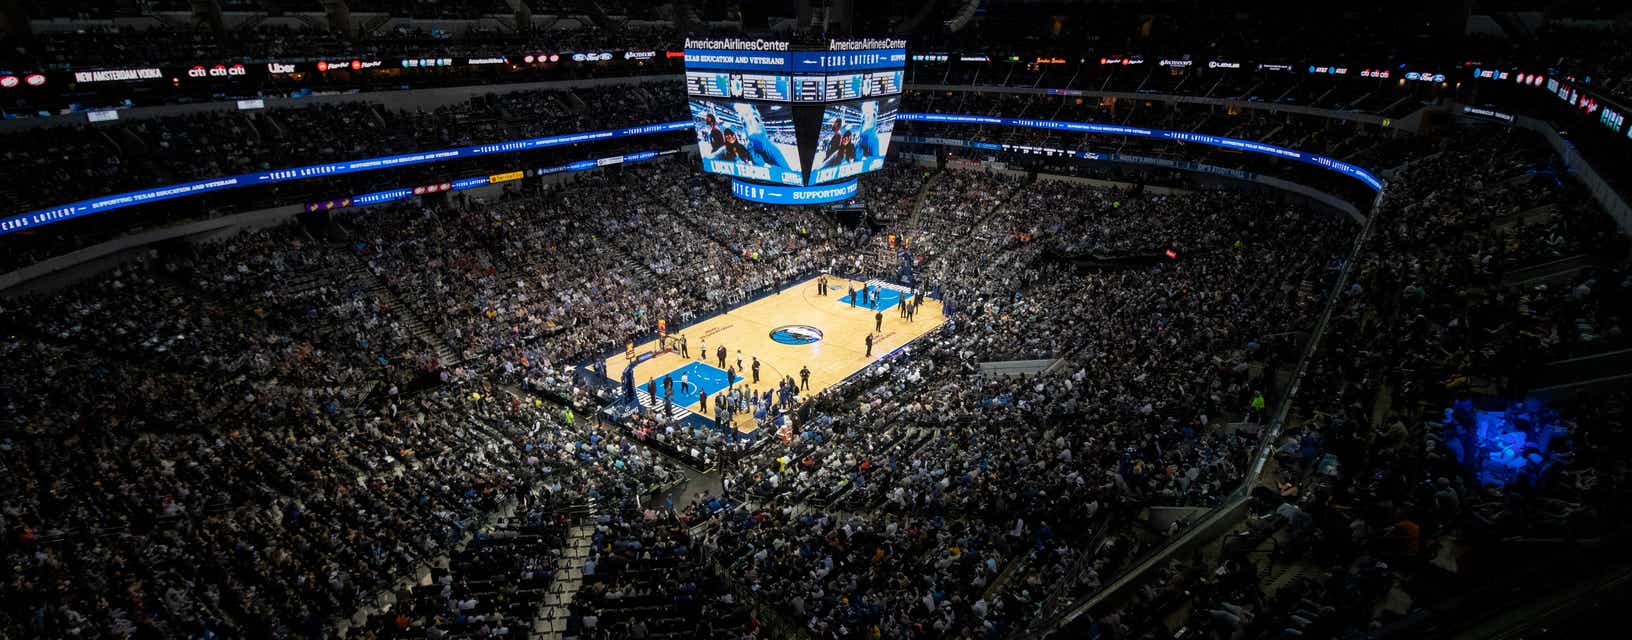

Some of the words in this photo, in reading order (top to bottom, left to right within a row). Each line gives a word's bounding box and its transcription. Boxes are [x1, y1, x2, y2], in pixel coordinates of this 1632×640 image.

[685, 38, 790, 51] AmericanAirlinesCenter
[830, 38, 907, 50] AmericanAirlinesCenter
[700, 55, 734, 63] EDUCATION
[735, 56, 749, 64] AND
[750, 57, 784, 65] VETERANS
[820, 55, 846, 67] TEXAS
[850, 54, 880, 66] LOTTERY
[188, 67, 206, 77] citi
[210, 66, 227, 76] citi
[228, 66, 246, 75] citi
[268, 63, 295, 73] Uber
[75, 71, 93, 82] NEW
[93, 70, 138, 81] AMSTERDAM
[138, 68, 162, 79] VODKA
[301, 166, 336, 176] LOTTERY
[711, 160, 735, 176] LUCKY
[792, 187, 846, 200] SUPPORTING
[33, 207, 75, 224] LOTTERY
